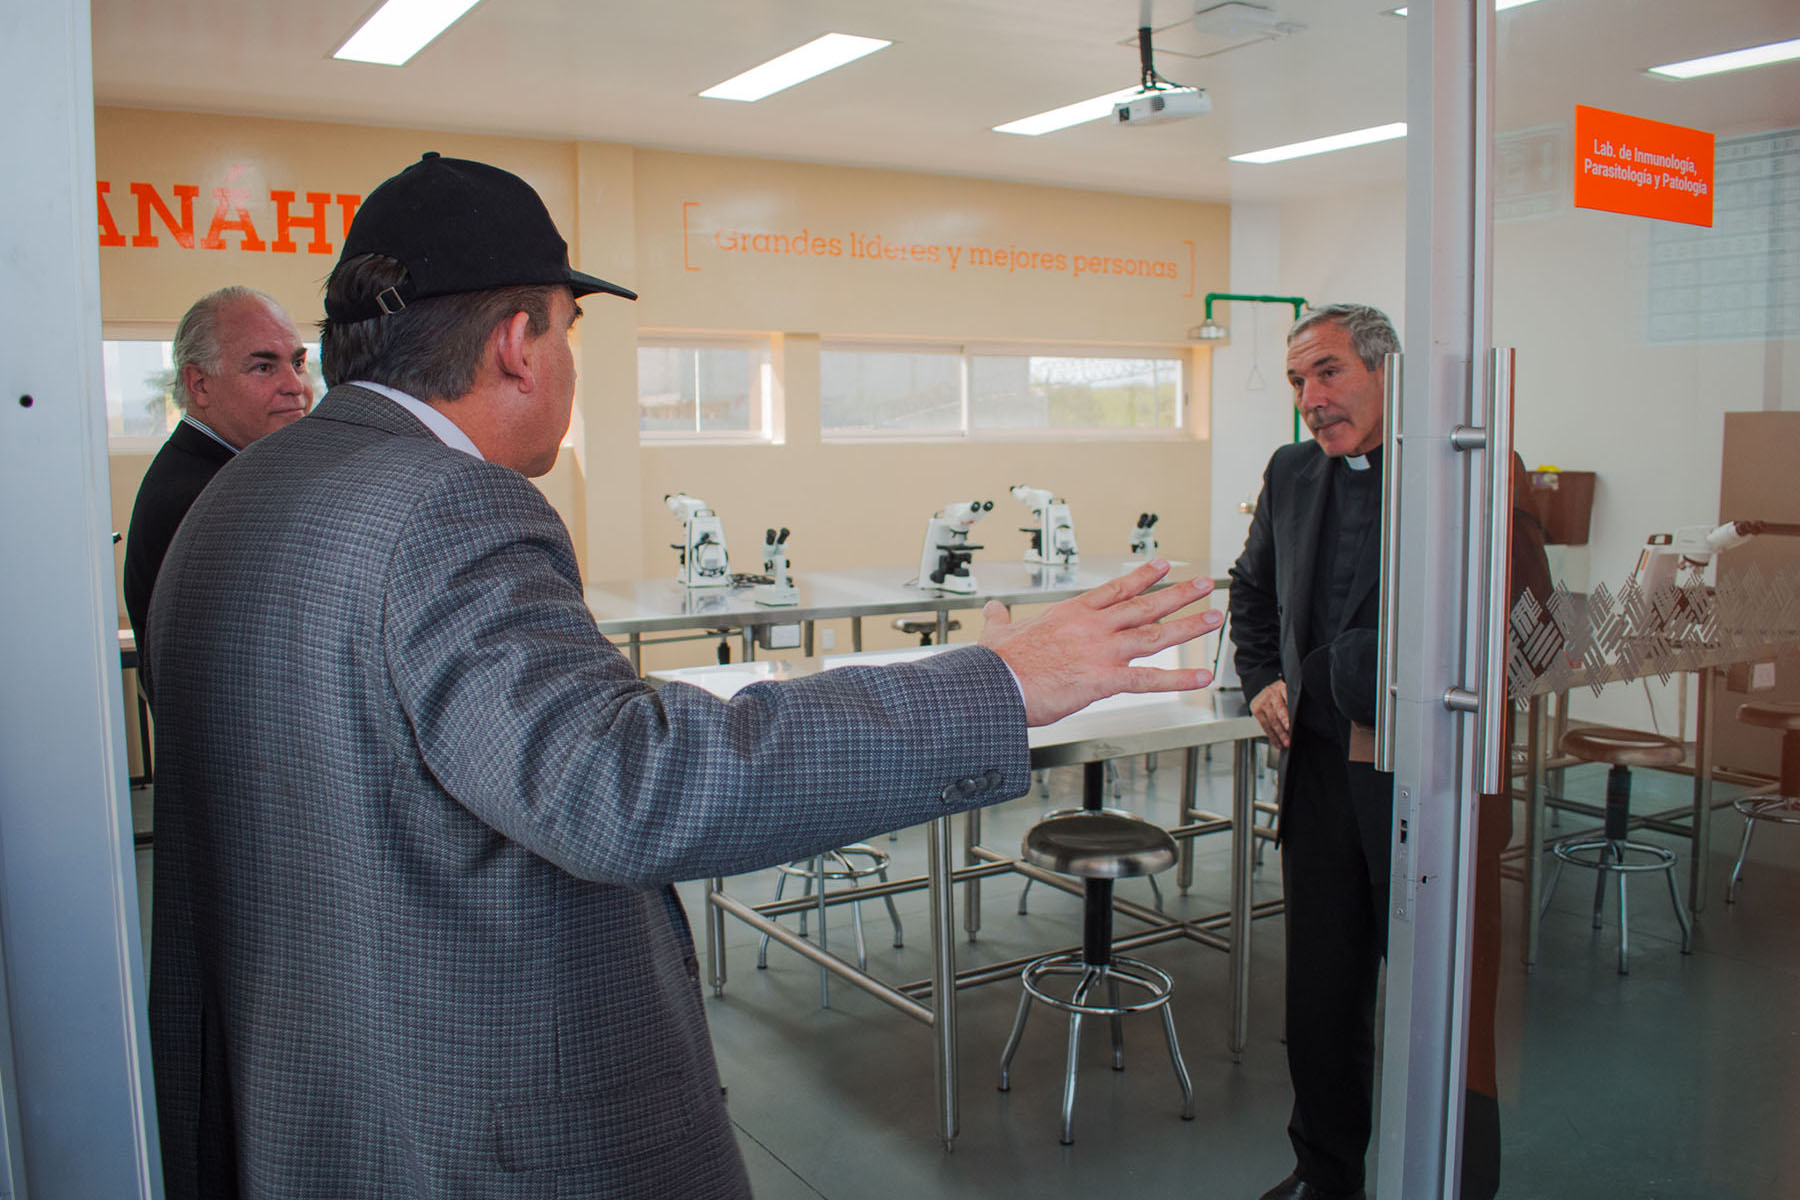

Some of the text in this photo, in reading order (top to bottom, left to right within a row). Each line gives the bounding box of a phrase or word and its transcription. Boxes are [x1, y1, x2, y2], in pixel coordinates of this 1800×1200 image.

[1584, 157, 1708, 197] Parasitología y Patología
[1593, 138, 1617, 158] Lab.
[1619, 143, 1632, 161] de
[1634, 146, 1697, 176] Inmunología,
[715, 226, 1178, 280] Grandes líderes y mejores personas
